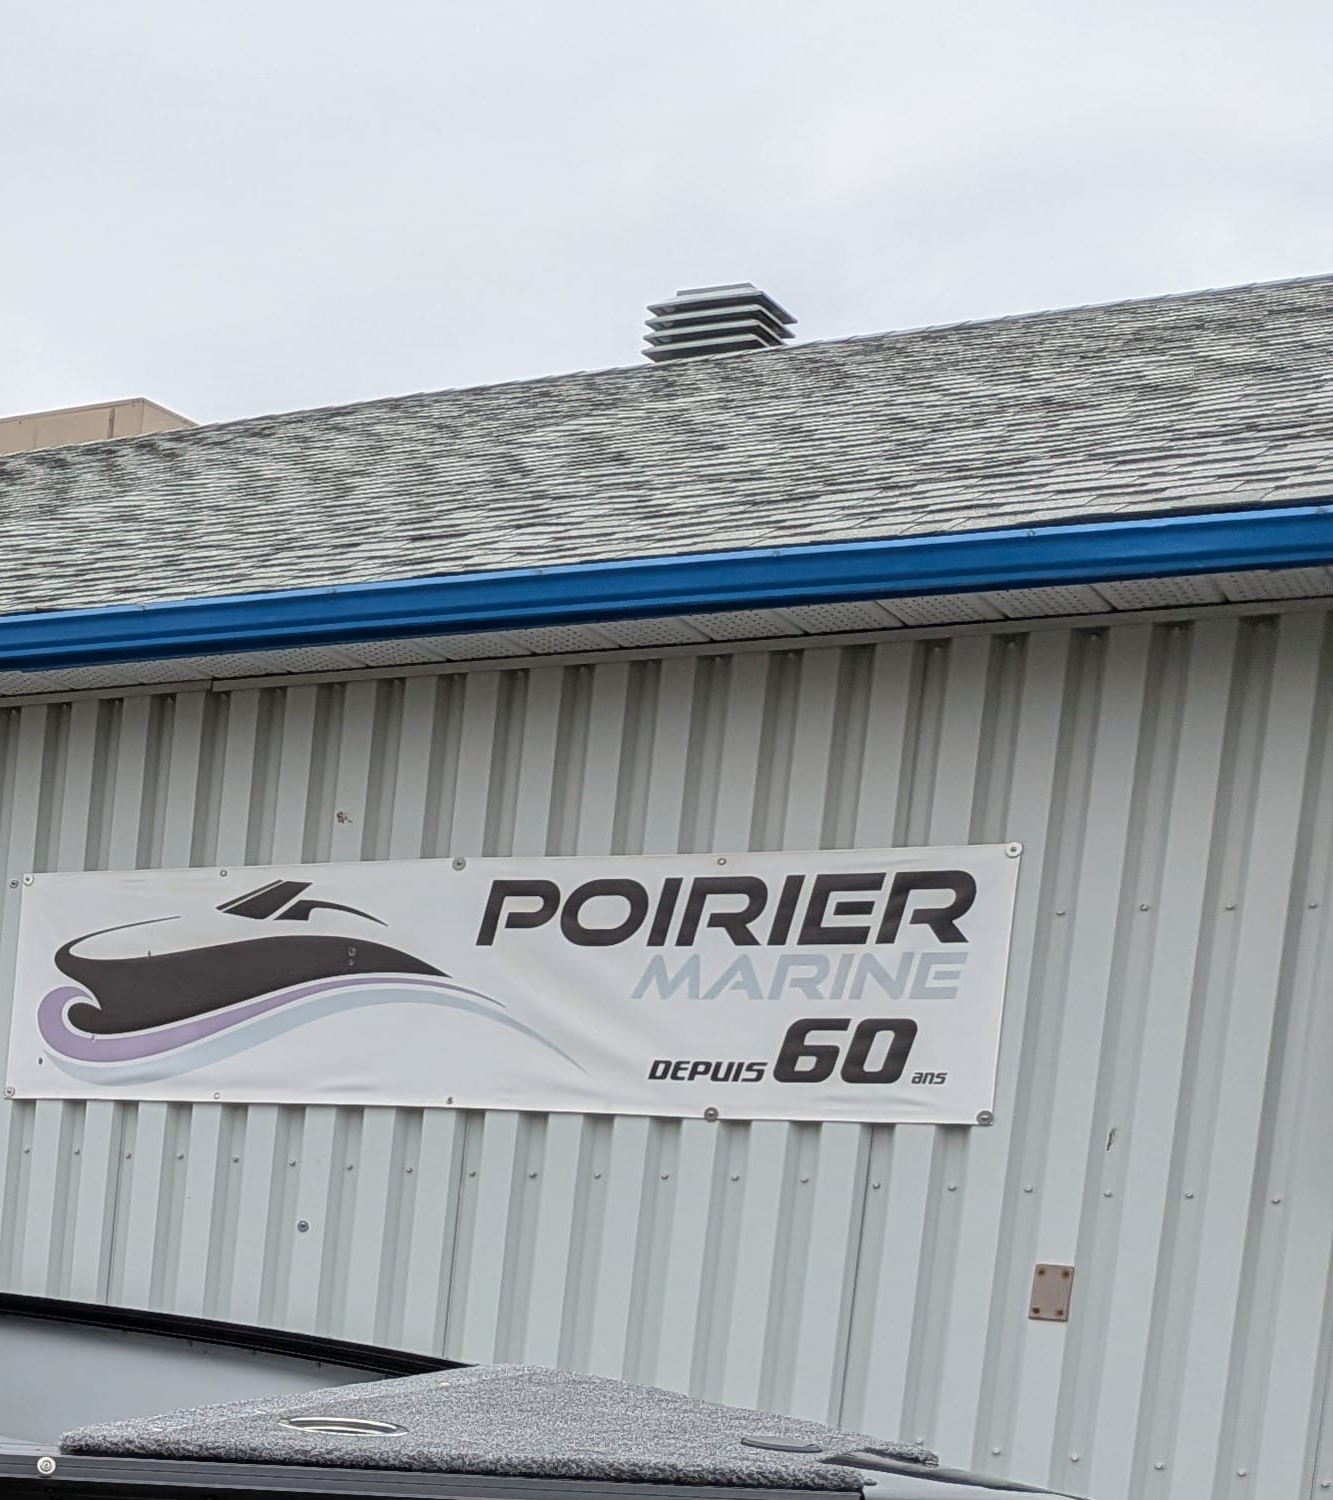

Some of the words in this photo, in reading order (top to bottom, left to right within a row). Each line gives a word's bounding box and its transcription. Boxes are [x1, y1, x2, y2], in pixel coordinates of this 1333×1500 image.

[476, 869, 977, 947] POIRIER
[631, 951, 969, 1001] MARINE
[648, 1060, 768, 1083] DEPUIS
[773, 1018, 918, 1084] 60
[911, 1070, 948, 1086] ans
